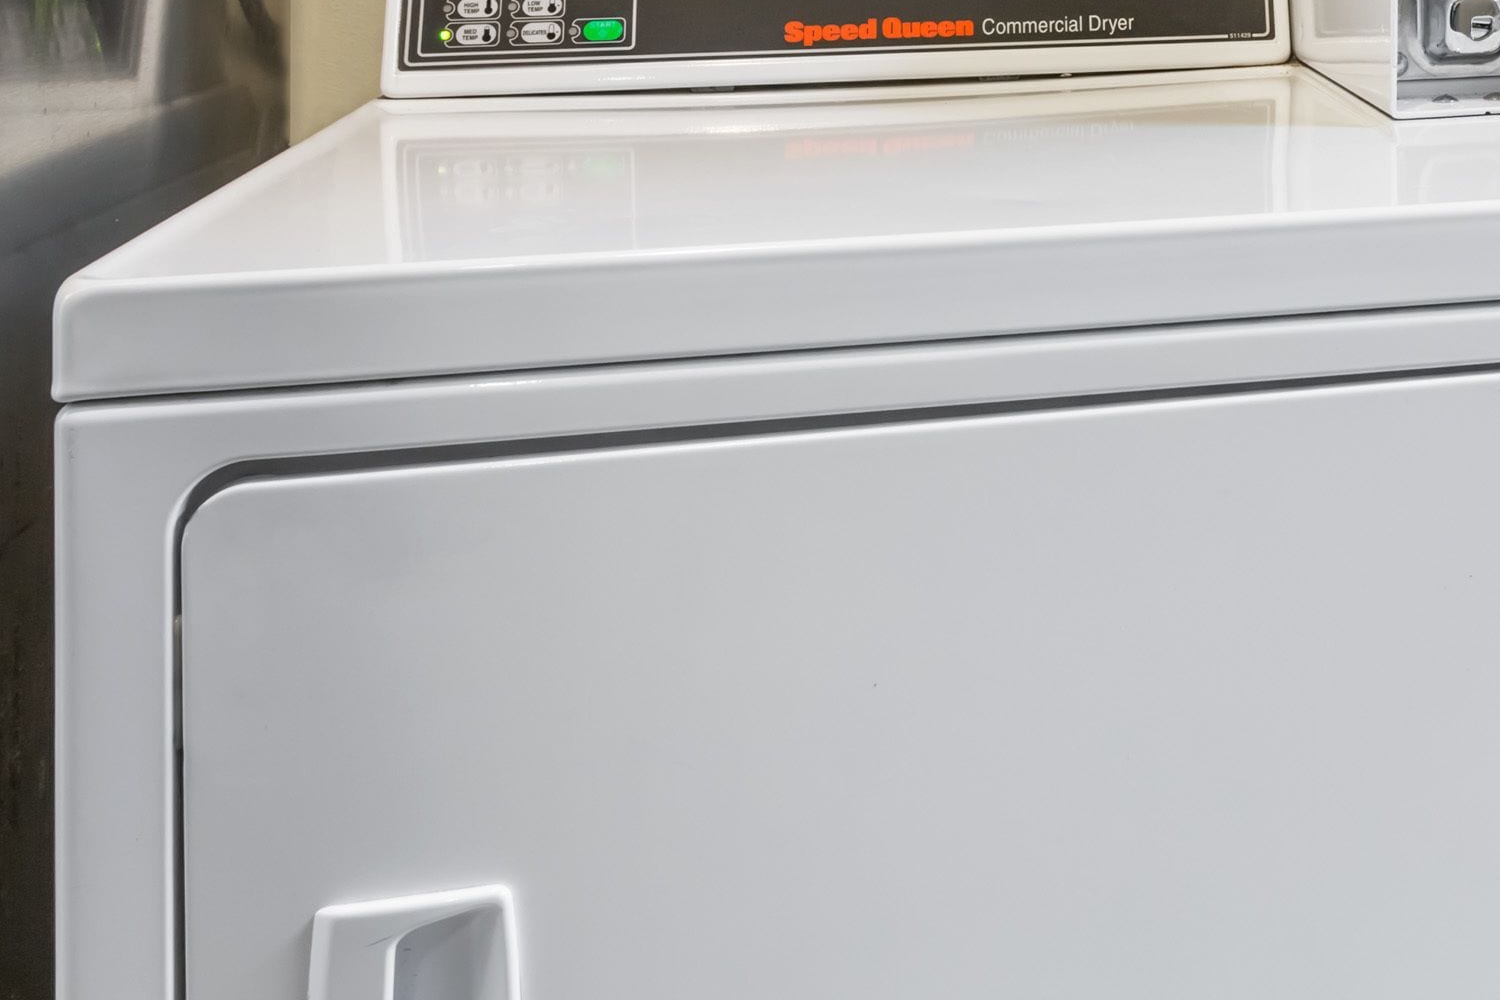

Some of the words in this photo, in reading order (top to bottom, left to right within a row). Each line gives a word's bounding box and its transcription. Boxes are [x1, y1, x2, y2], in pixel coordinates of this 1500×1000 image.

[784, 17, 878, 47] Speed
[881, 16, 975, 40] Queen
[982, 15, 1083, 36] Commercial
[1088, 14, 1135, 35] Dryer
